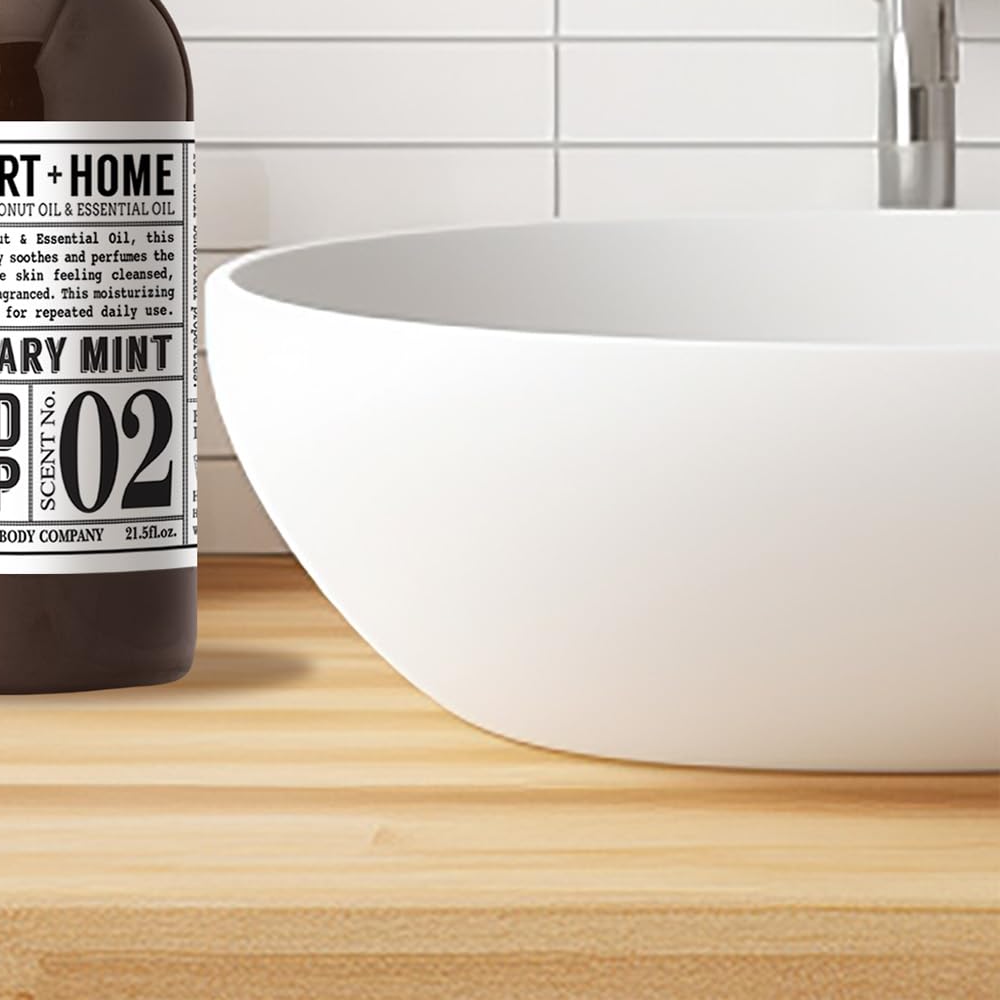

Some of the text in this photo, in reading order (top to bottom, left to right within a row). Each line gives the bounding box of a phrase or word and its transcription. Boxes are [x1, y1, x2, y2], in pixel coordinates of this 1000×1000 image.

[47, 165, 63, 185] +
[70, 153, 175, 198] HOME
[38, 202, 62, 217] OIL
[64, 202, 74, 217] &
[77, 201, 149, 217] ESSENTIAL
[151, 201, 176, 216] OIL
[19, 233, 27, 245] &
[36, 231, 99, 245] Essential
[108, 231, 136, 246] Oil,
[146, 230, 175, 244] this
[9, 250, 59, 264] soothes
[64, 249, 86, 263] and
[90, 249, 148, 267] perfumes
[153, 248, 175, 262] the
[15, 268, 44, 282] skin
[53, 267, 103, 284] feeling
[111, 266, 173, 282] cleansed,
[60, 286, 89, 300] This
[92, 285, 176, 302] moisturizing
[6, 305, 28, 319] for
[35, 304, 94, 322] repeated
[100, 304, 138, 321] daily
[144, 306, 173, 317] use.
[79, 334, 173, 374] MINT
[40, 390, 56, 511] SCENT No.
[58, 388, 174, 514] 02
[38, 527, 105, 544] COMPANY
